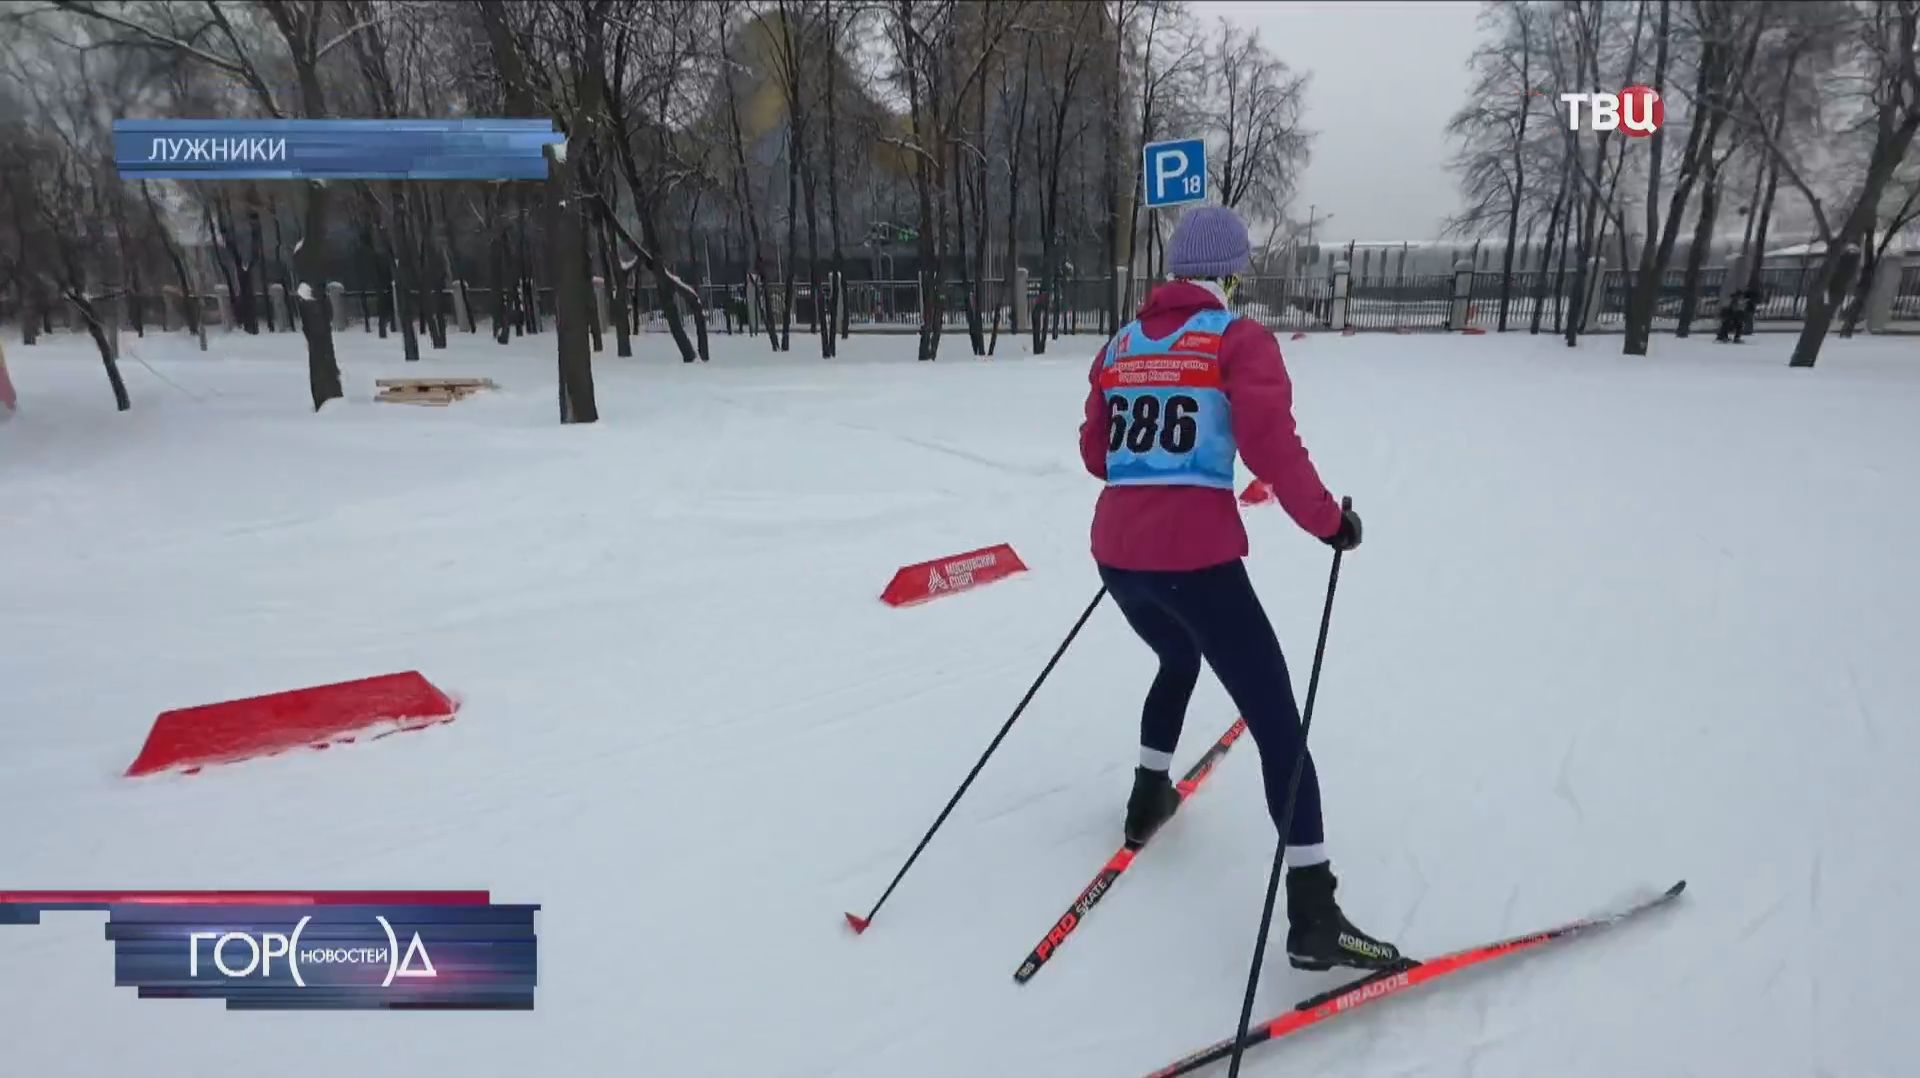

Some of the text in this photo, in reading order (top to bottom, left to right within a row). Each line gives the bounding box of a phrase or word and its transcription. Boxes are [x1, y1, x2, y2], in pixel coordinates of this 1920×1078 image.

[1156, 149, 1189, 199] P
[1182, 174, 1201, 195] 18
[1108, 394, 1199, 454] 686
[1035, 878, 1107, 961] PRO SKATE
[1336, 970, 1409, 1010] BRADOS
